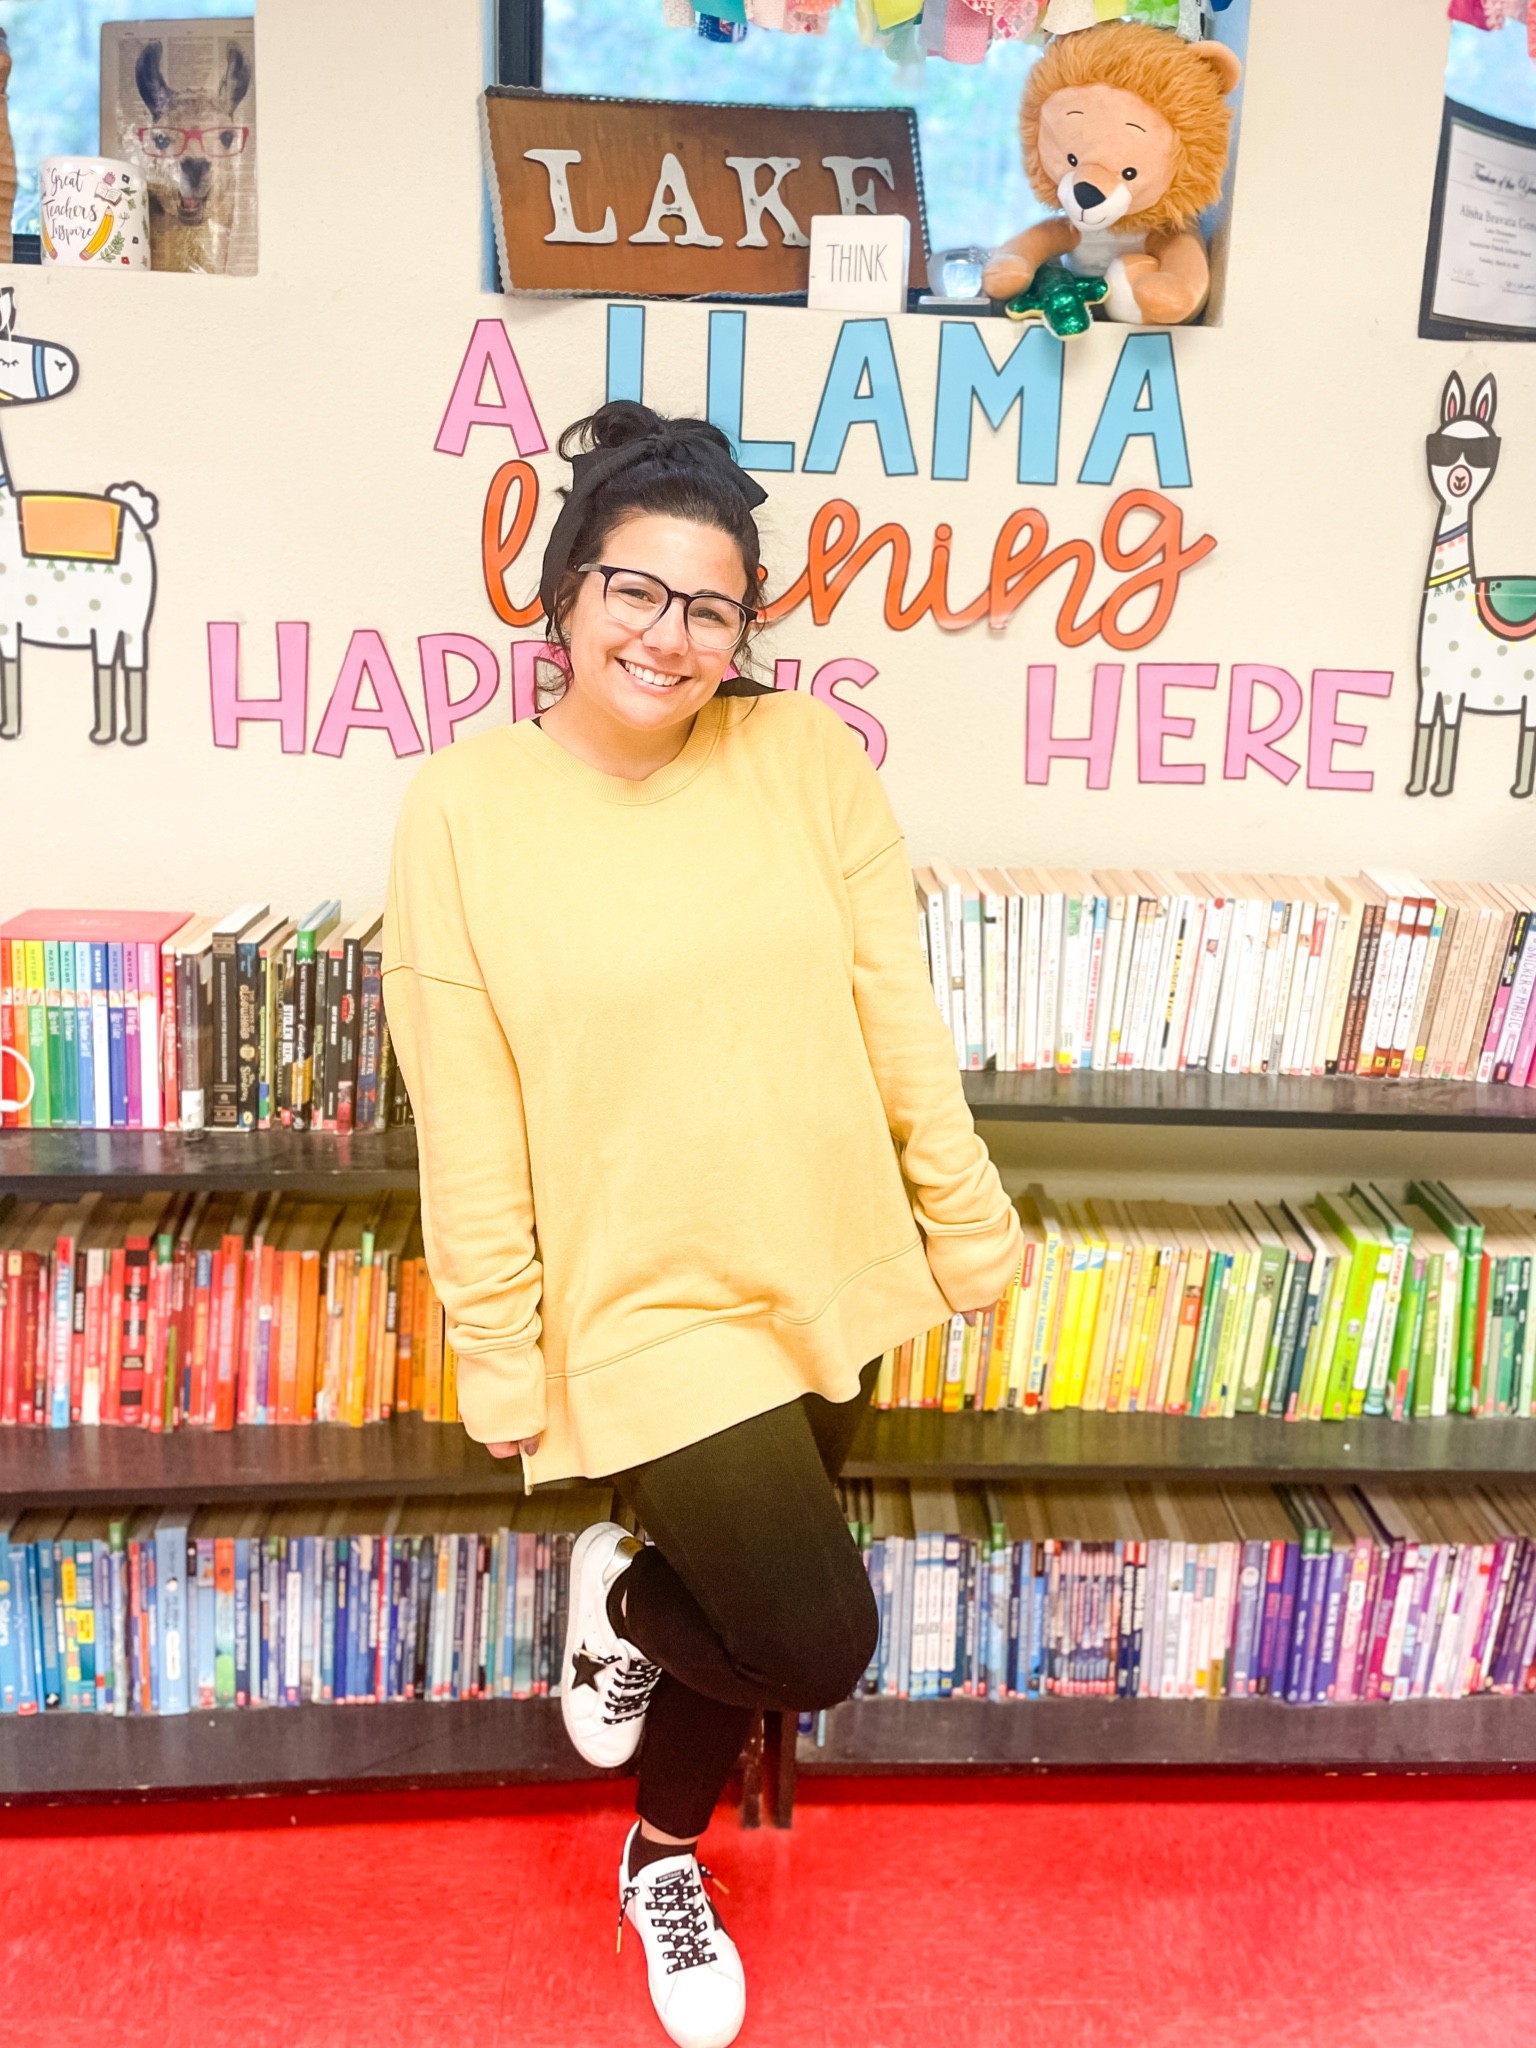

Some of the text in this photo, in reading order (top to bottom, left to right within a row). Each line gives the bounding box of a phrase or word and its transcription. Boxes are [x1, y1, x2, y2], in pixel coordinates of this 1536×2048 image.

[50, 168, 95, 196] Great
[524, 148, 895, 248] LAKE
[43, 196, 98, 222] Teachers
[50, 217, 94, 245] Inspire
[826, 244, 889, 284] THINK
[434, 318, 548, 457] A
[1025, 663, 1394, 792] HERE
[1089, 954, 1099, 994] POPPER'S
[1507, 945, 1536, 1029] SNICKER MAGIC
[283, 1005, 293, 1040] STOLEN
[366, 994, 376, 1075] HARRY POTTER
[1084, 997, 1095, 1042] PENGUINS
[1045, 1256, 1055, 1272] Old
[1047, 1238, 1058, 1253] The
[1039, 1274, 1053, 1312] Farmer's
[1034, 1314, 1047, 1351] Almanac
[1028, 1370, 1040, 1390] Kids
[1321, 1592, 1340, 1663] BLACK BEAUTY
